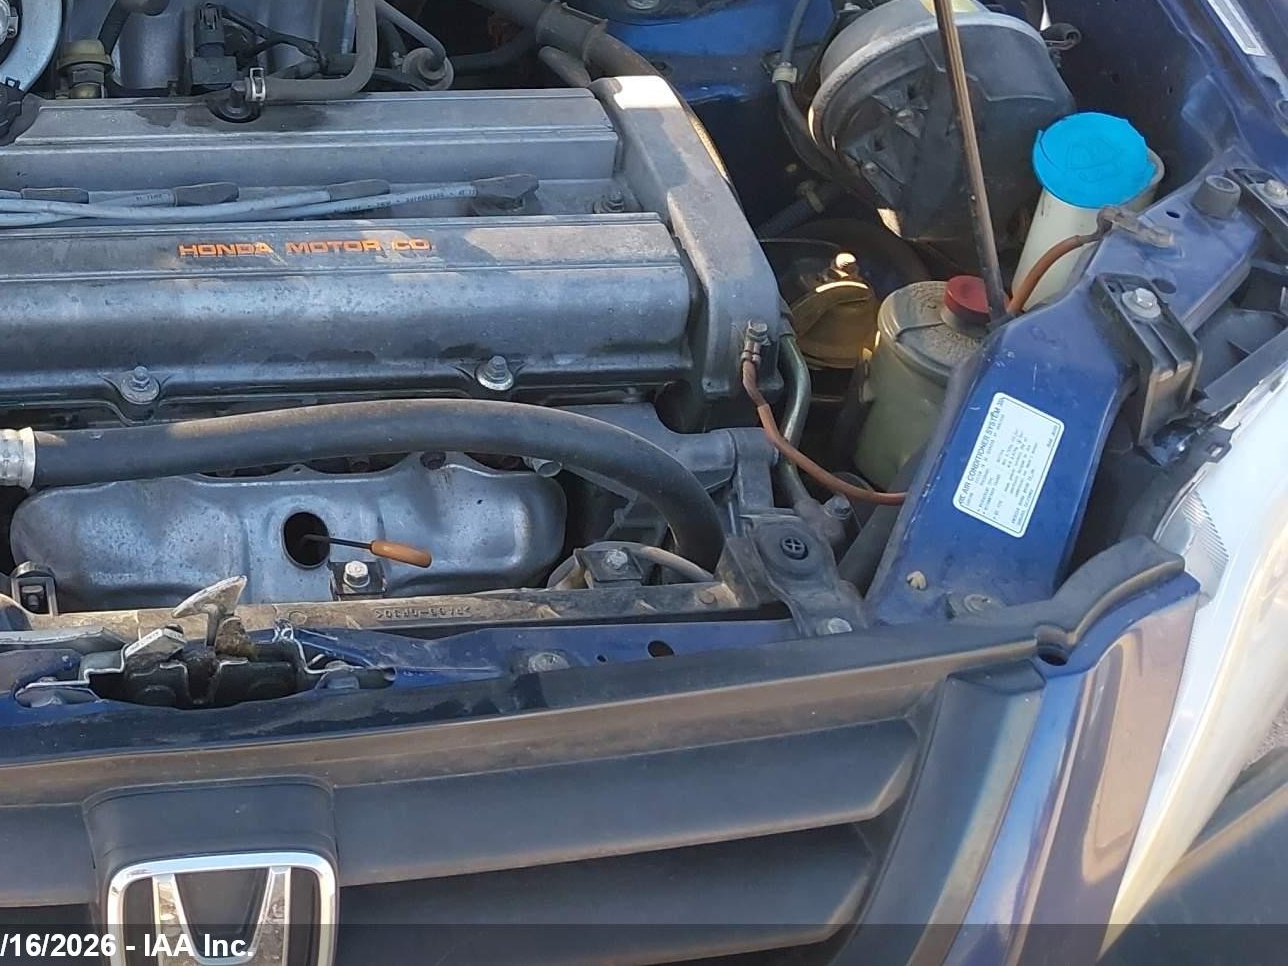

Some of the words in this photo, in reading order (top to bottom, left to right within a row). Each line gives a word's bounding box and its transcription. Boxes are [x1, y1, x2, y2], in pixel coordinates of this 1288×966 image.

[177, 241, 274, 259] HONDA
[285, 240, 382, 255] MOTOR
[966, 435, 990, 481] CONDITIONER
